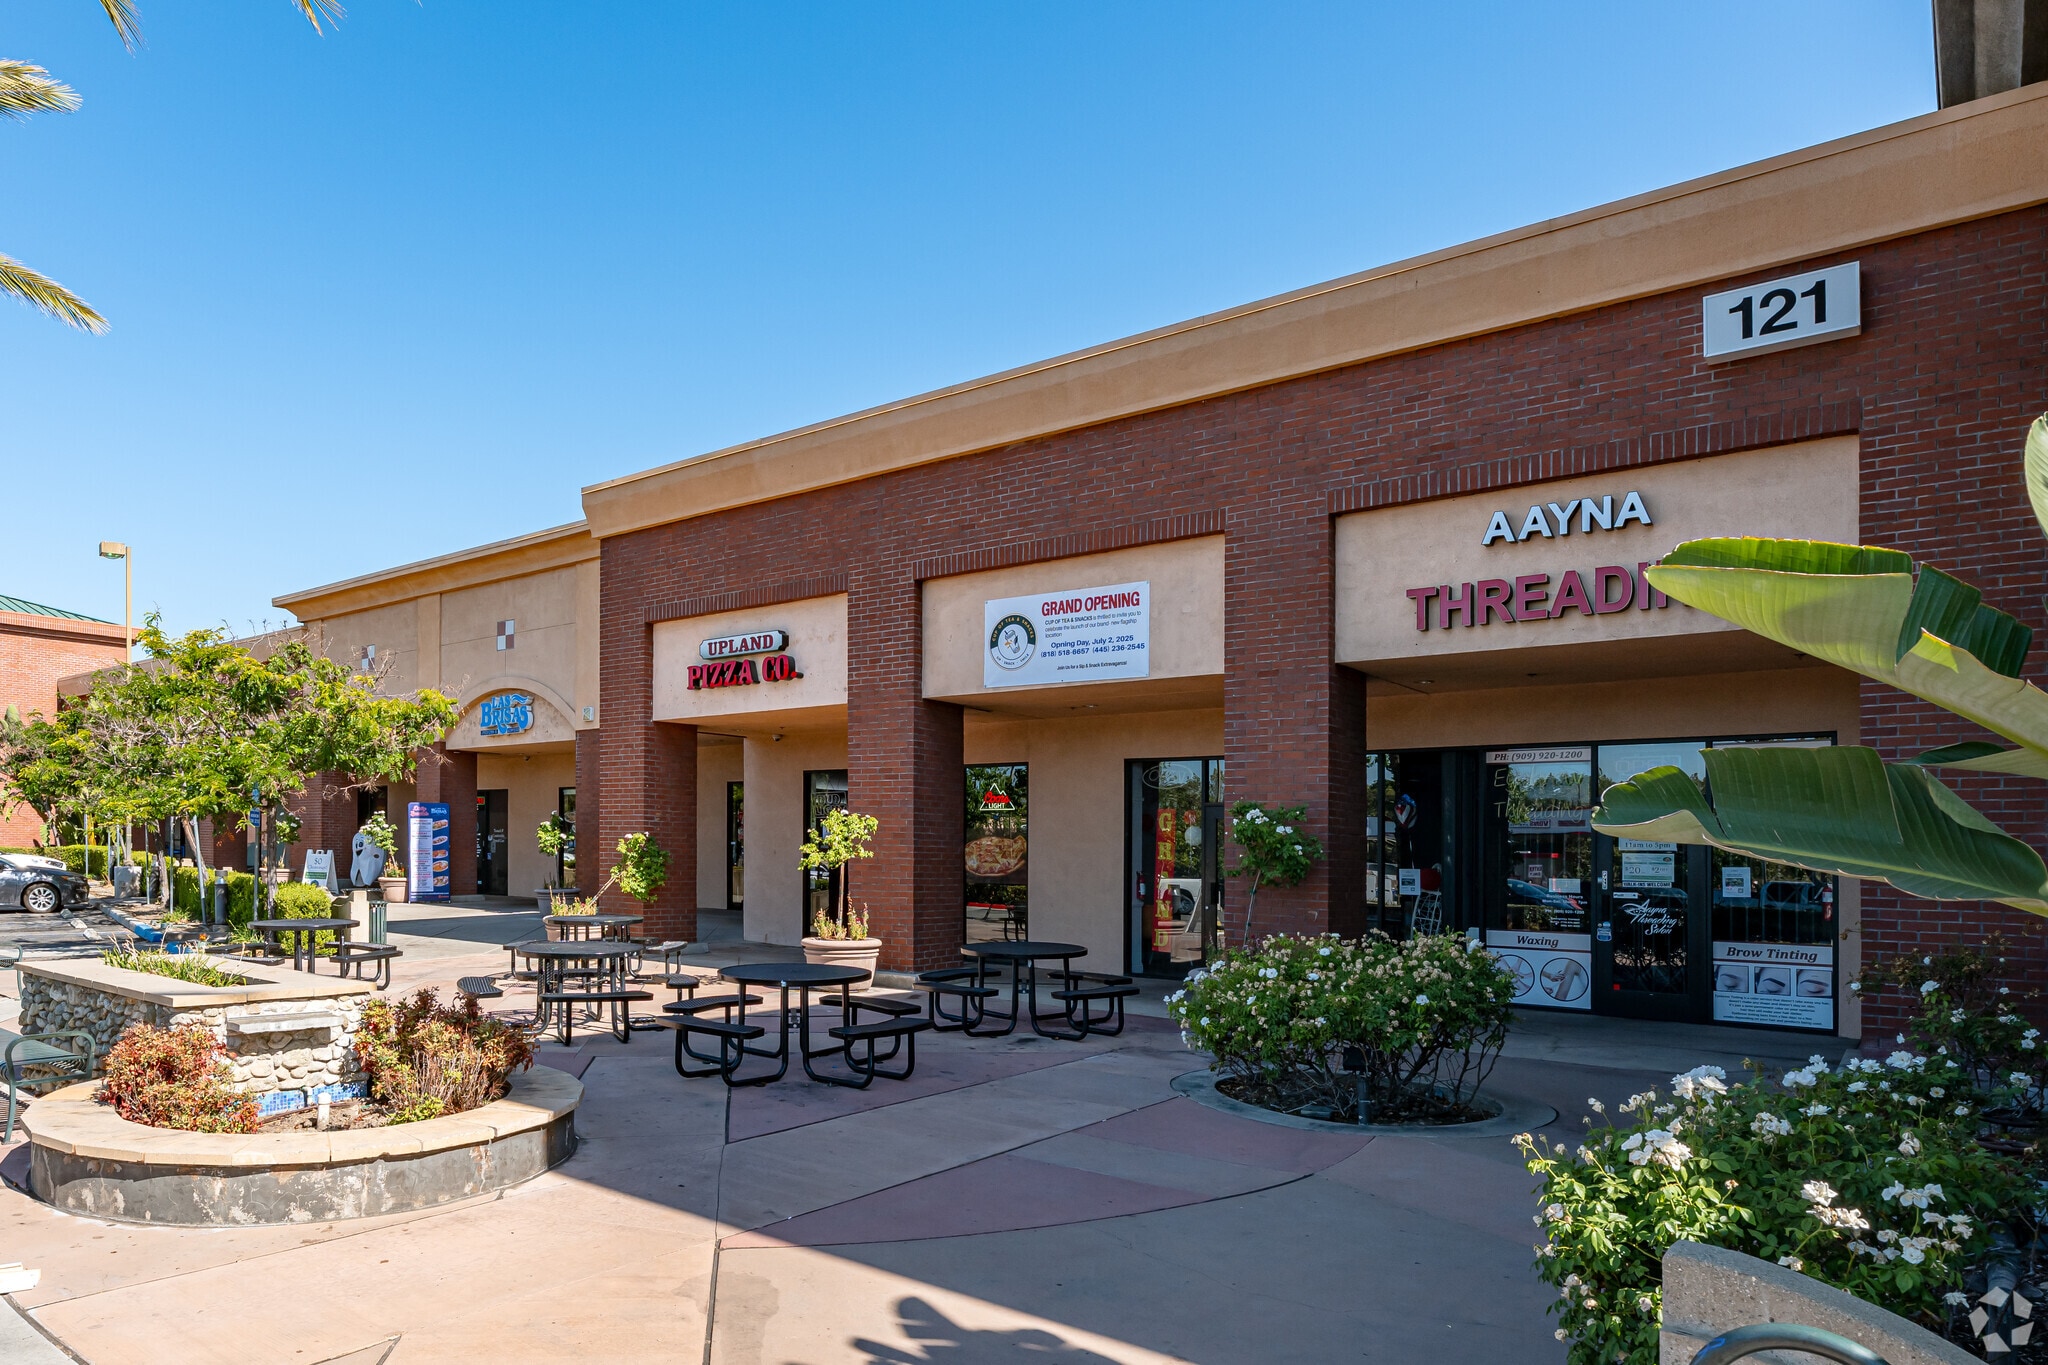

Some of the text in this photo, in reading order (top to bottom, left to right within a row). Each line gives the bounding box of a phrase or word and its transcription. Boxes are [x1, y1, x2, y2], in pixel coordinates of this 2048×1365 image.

[1729, 279, 1826, 340] 121
[1482, 491, 1652, 546] AAYNA
[1041, 591, 1140, 616] GRAND OPENING
[1406, 559, 1690, 632] THREADI
[707, 634, 774, 656] UPLAND
[1076, 639, 1090, 647] Day,
[1092, 637, 1107, 646] July
[1116, 634, 1134, 643] 2025
[1041, 650, 1056, 658] (818)
[1092, 645, 1110, 654] (445)
[1112, 642, 1145, 652] 236-2545
[687, 654, 800, 690] PIZZA CO.
[491, 694, 511, 709] LAS
[480, 701, 530, 734] BRISAS
[1511, 752, 1536, 762] (909)
[1539, 751, 1583, 760] 920-1200
[983, 790, 1011, 804] Coors
[1644, 924, 1672, 935] Salon
[1517, 935, 1559, 948] Waxing
[1726, 946, 1818, 963] Brow Tinting
